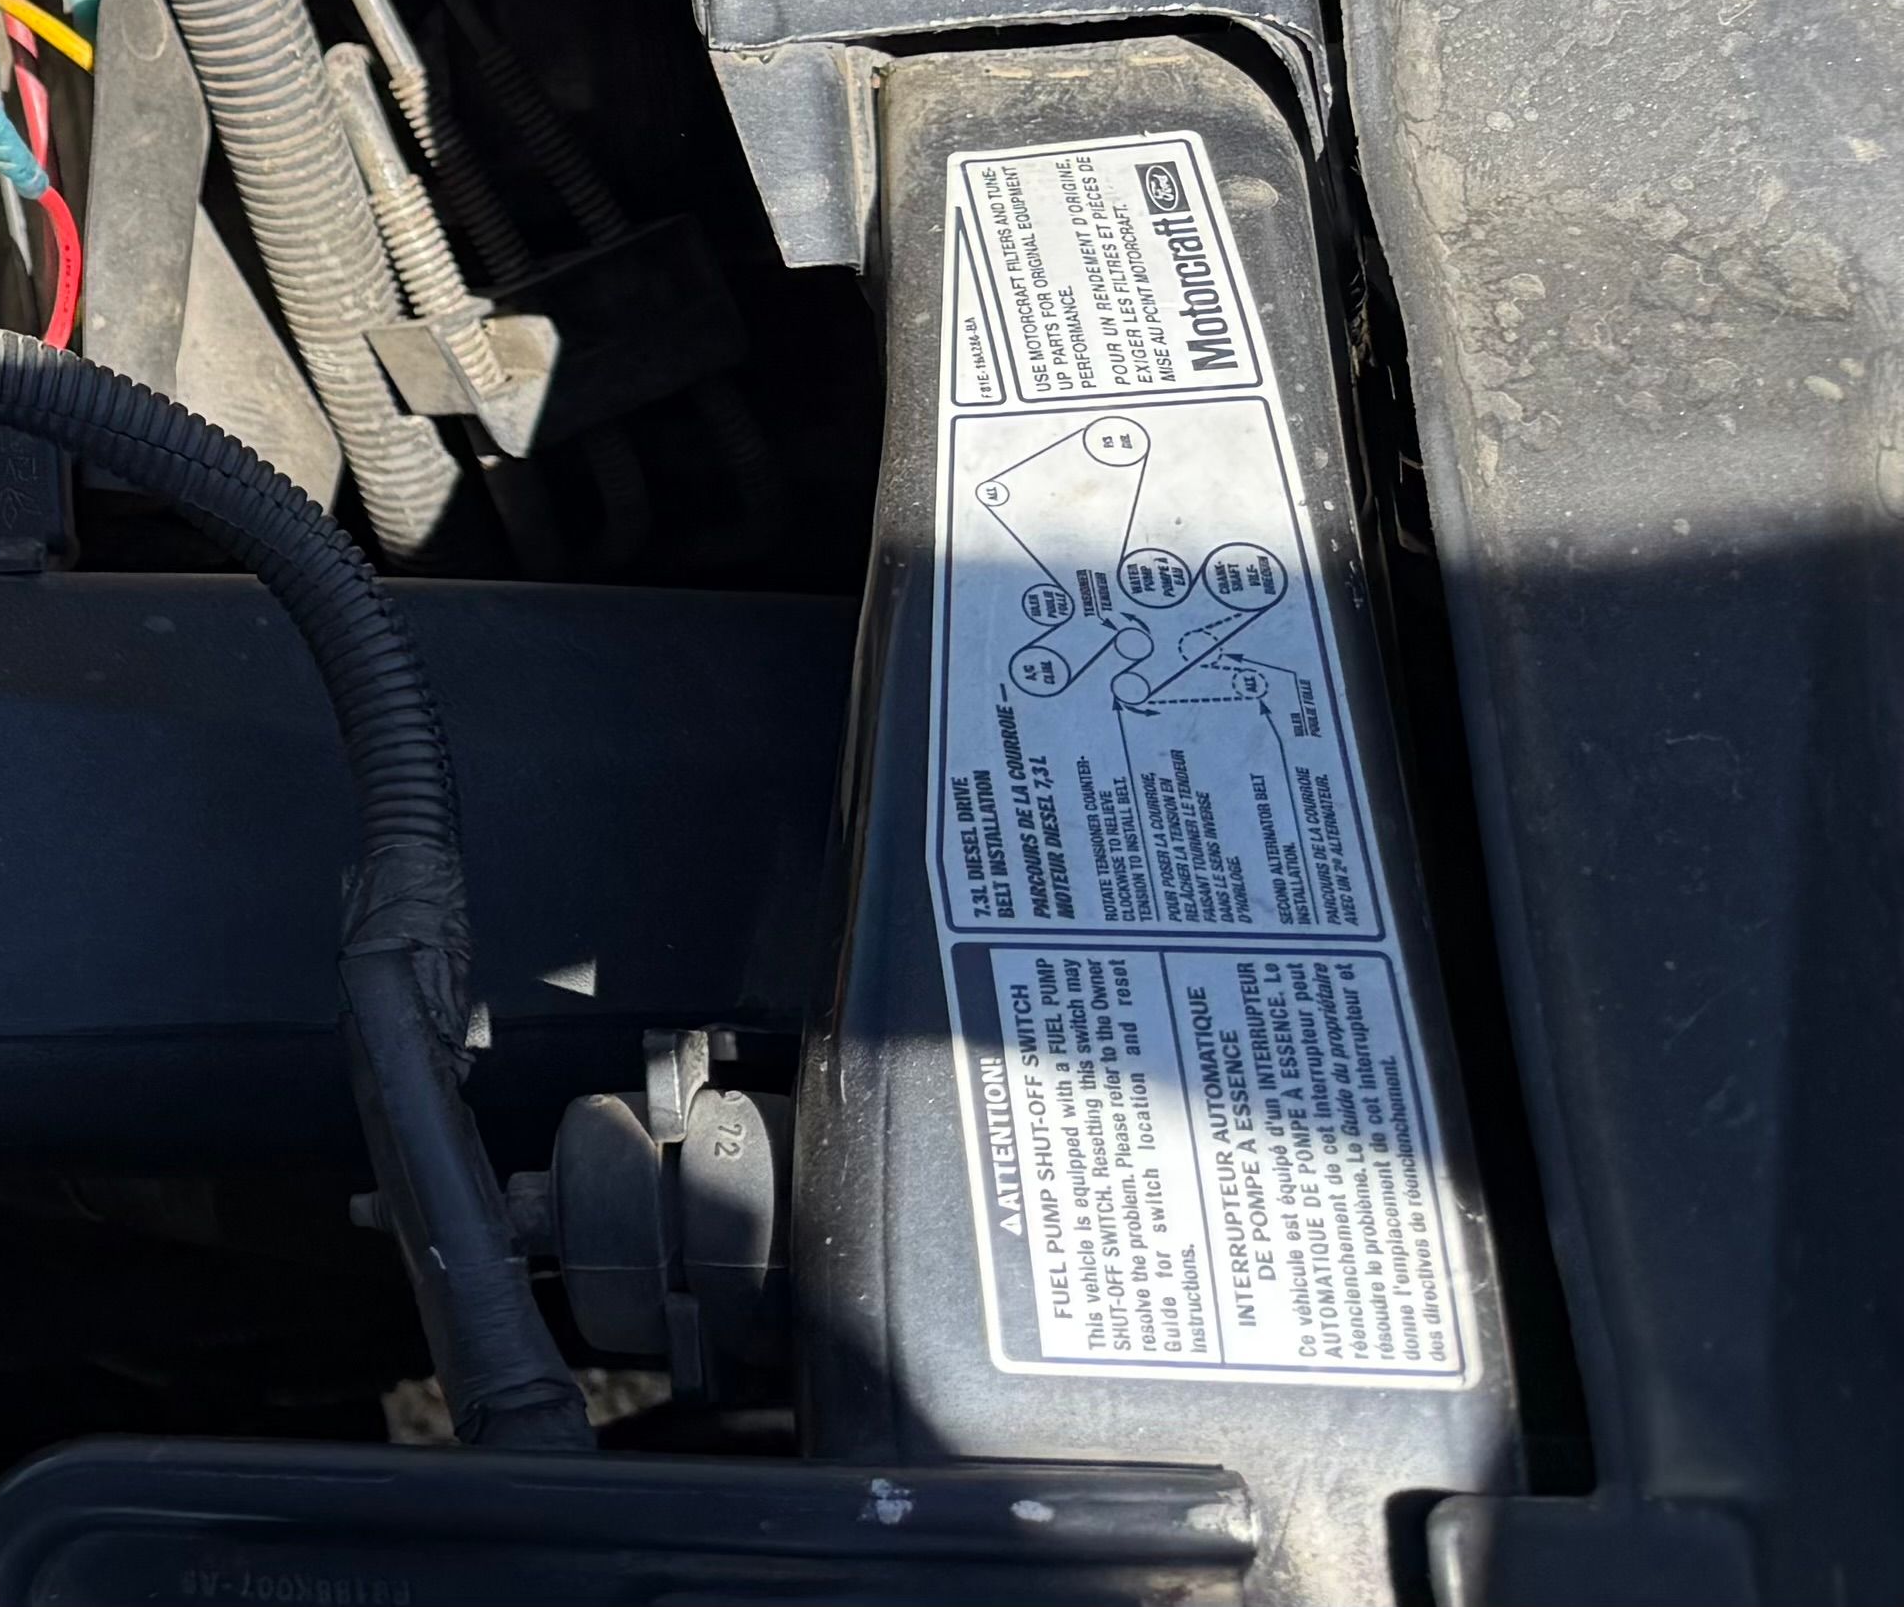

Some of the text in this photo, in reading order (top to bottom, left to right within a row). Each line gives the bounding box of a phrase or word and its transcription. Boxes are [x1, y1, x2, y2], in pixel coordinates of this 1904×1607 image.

[982, 167, 1051, 391] USE MOTORCRAFT FILTERS AND TUNE-
[1002, 166, 1073, 390] UP PARTS FOR ORIGINAL EQUIPMENT
[1056, 158, 1130, 385] POUR UN RENDEMENT D'ORIGINE,
[1076, 156, 1153, 383] EXIGER LES FILTRES ET PIÈCES DE
[1113, 204, 1148, 282] MOTORCRAFT.
[1152, 214, 1238, 370] Motorcraft
[1058, 285, 1096, 388] PERFORMANCE.
[1147, 326, 1166, 345] AU
[1153, 348, 1175, 381] MISE
[951, 776, 991, 917] 7.3L DIESEL DRIVE
[973, 769, 1014, 918] BELT INSTALLATION
[996, 705, 1050, 918] PARCOURS DE LA COURROIE
[1037, 794, 1062, 847] DIESEL
[1047, 851, 1074, 918] MOTEUR
[1086, 813, 1109, 875] TENSIONER
[1099, 790, 1135, 921] CLOCKWISE TO RELIEVE
[1113, 776, 1152, 921] TENSION TO INSTALL BELT.
[1098, 879, 1118, 921] ROTATE
[713, 1123, 744, 1158] 72
[980, 1057, 1020, 1210] ATTENTION!
[1010, 984, 1072, 1318] FUEL PUMP SHUT-OFF SWITCH
[1035, 957, 1106, 1349] This vehicle is equipped with a FUEL PUMP
[1063, 958, 1131, 1350] SHUT-OFF SWITCH. Resetting this switch may
[1087, 958, 1156, 1351] resolve the problem. Please refer to the Owner
[1108, 959, 1182, 1352] Guide for switch location and reset
[1187, 987, 1255, 1325] INTERRUPTEUR AUTOMATIQUE
[1219, 1030, 1276, 1280] DE POMPE À ESSENCE
[1181, 1244, 1206, 1352] instructions.
